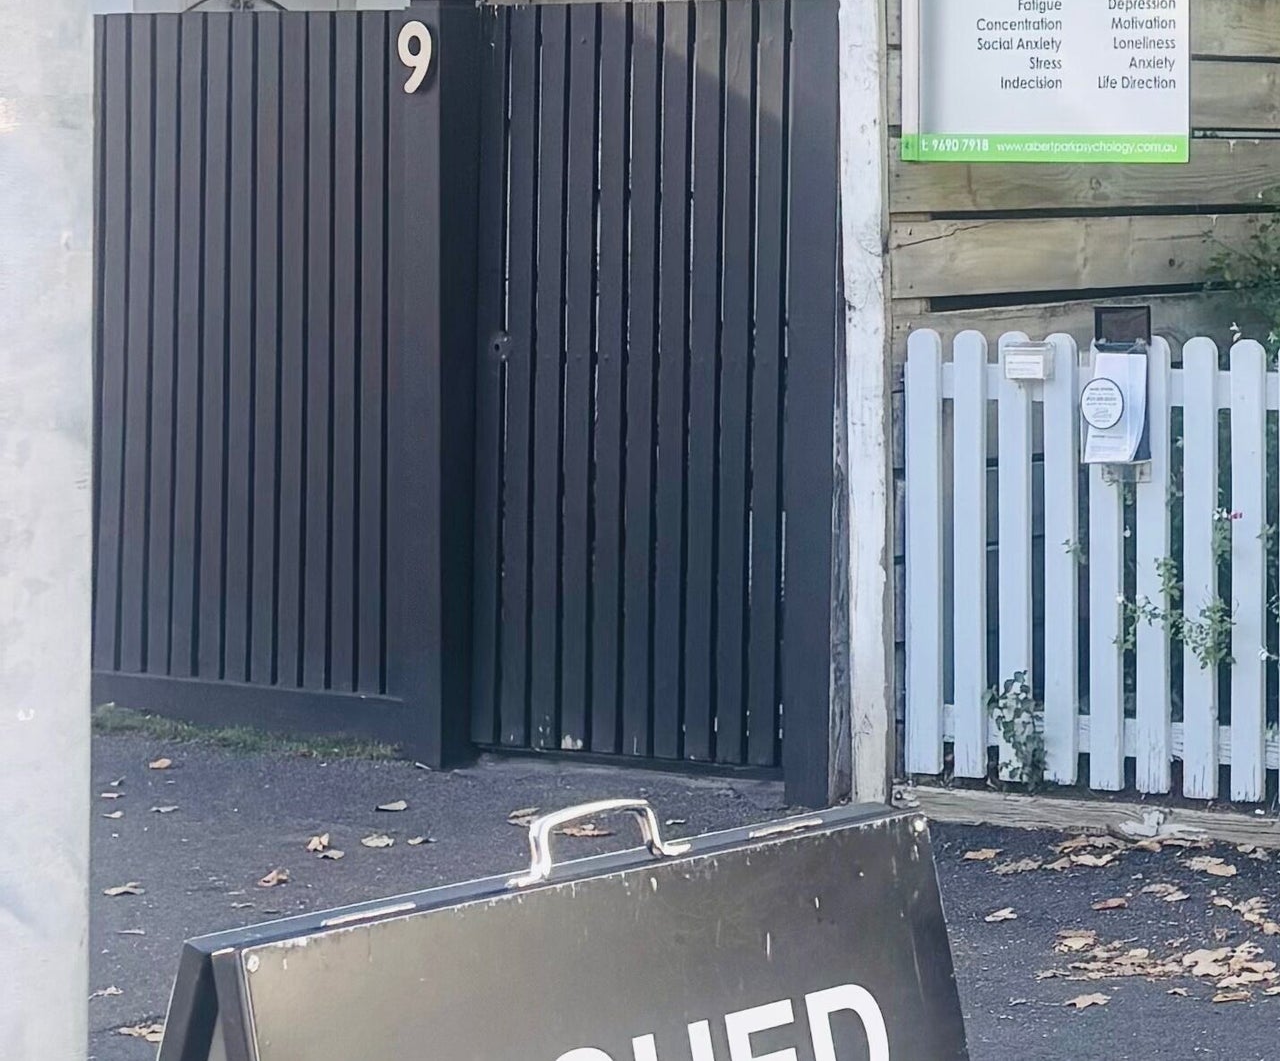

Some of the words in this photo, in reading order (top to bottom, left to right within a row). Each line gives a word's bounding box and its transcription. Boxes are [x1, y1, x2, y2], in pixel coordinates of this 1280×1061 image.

[976, 18, 1062, 31] Concentration
[1111, 16, 1176, 30] Motivation
[977, 37, 1013, 50] Social
[1017, 37, 1062, 53] Anxiety
[1113, 36, 1176, 49] Loneliness
[397, 20, 432, 94] 9
[1029, 56, 1062, 70] Stress
[1129, 56, 1176, 72] Anxiety
[1001, 76, 1062, 89] Indecision
[1098, 76, 1117, 89] Life
[1121, 76, 1176, 89] Direction
[932, 138, 959, 152] 9690
[962, 138, 989, 152] 7918
